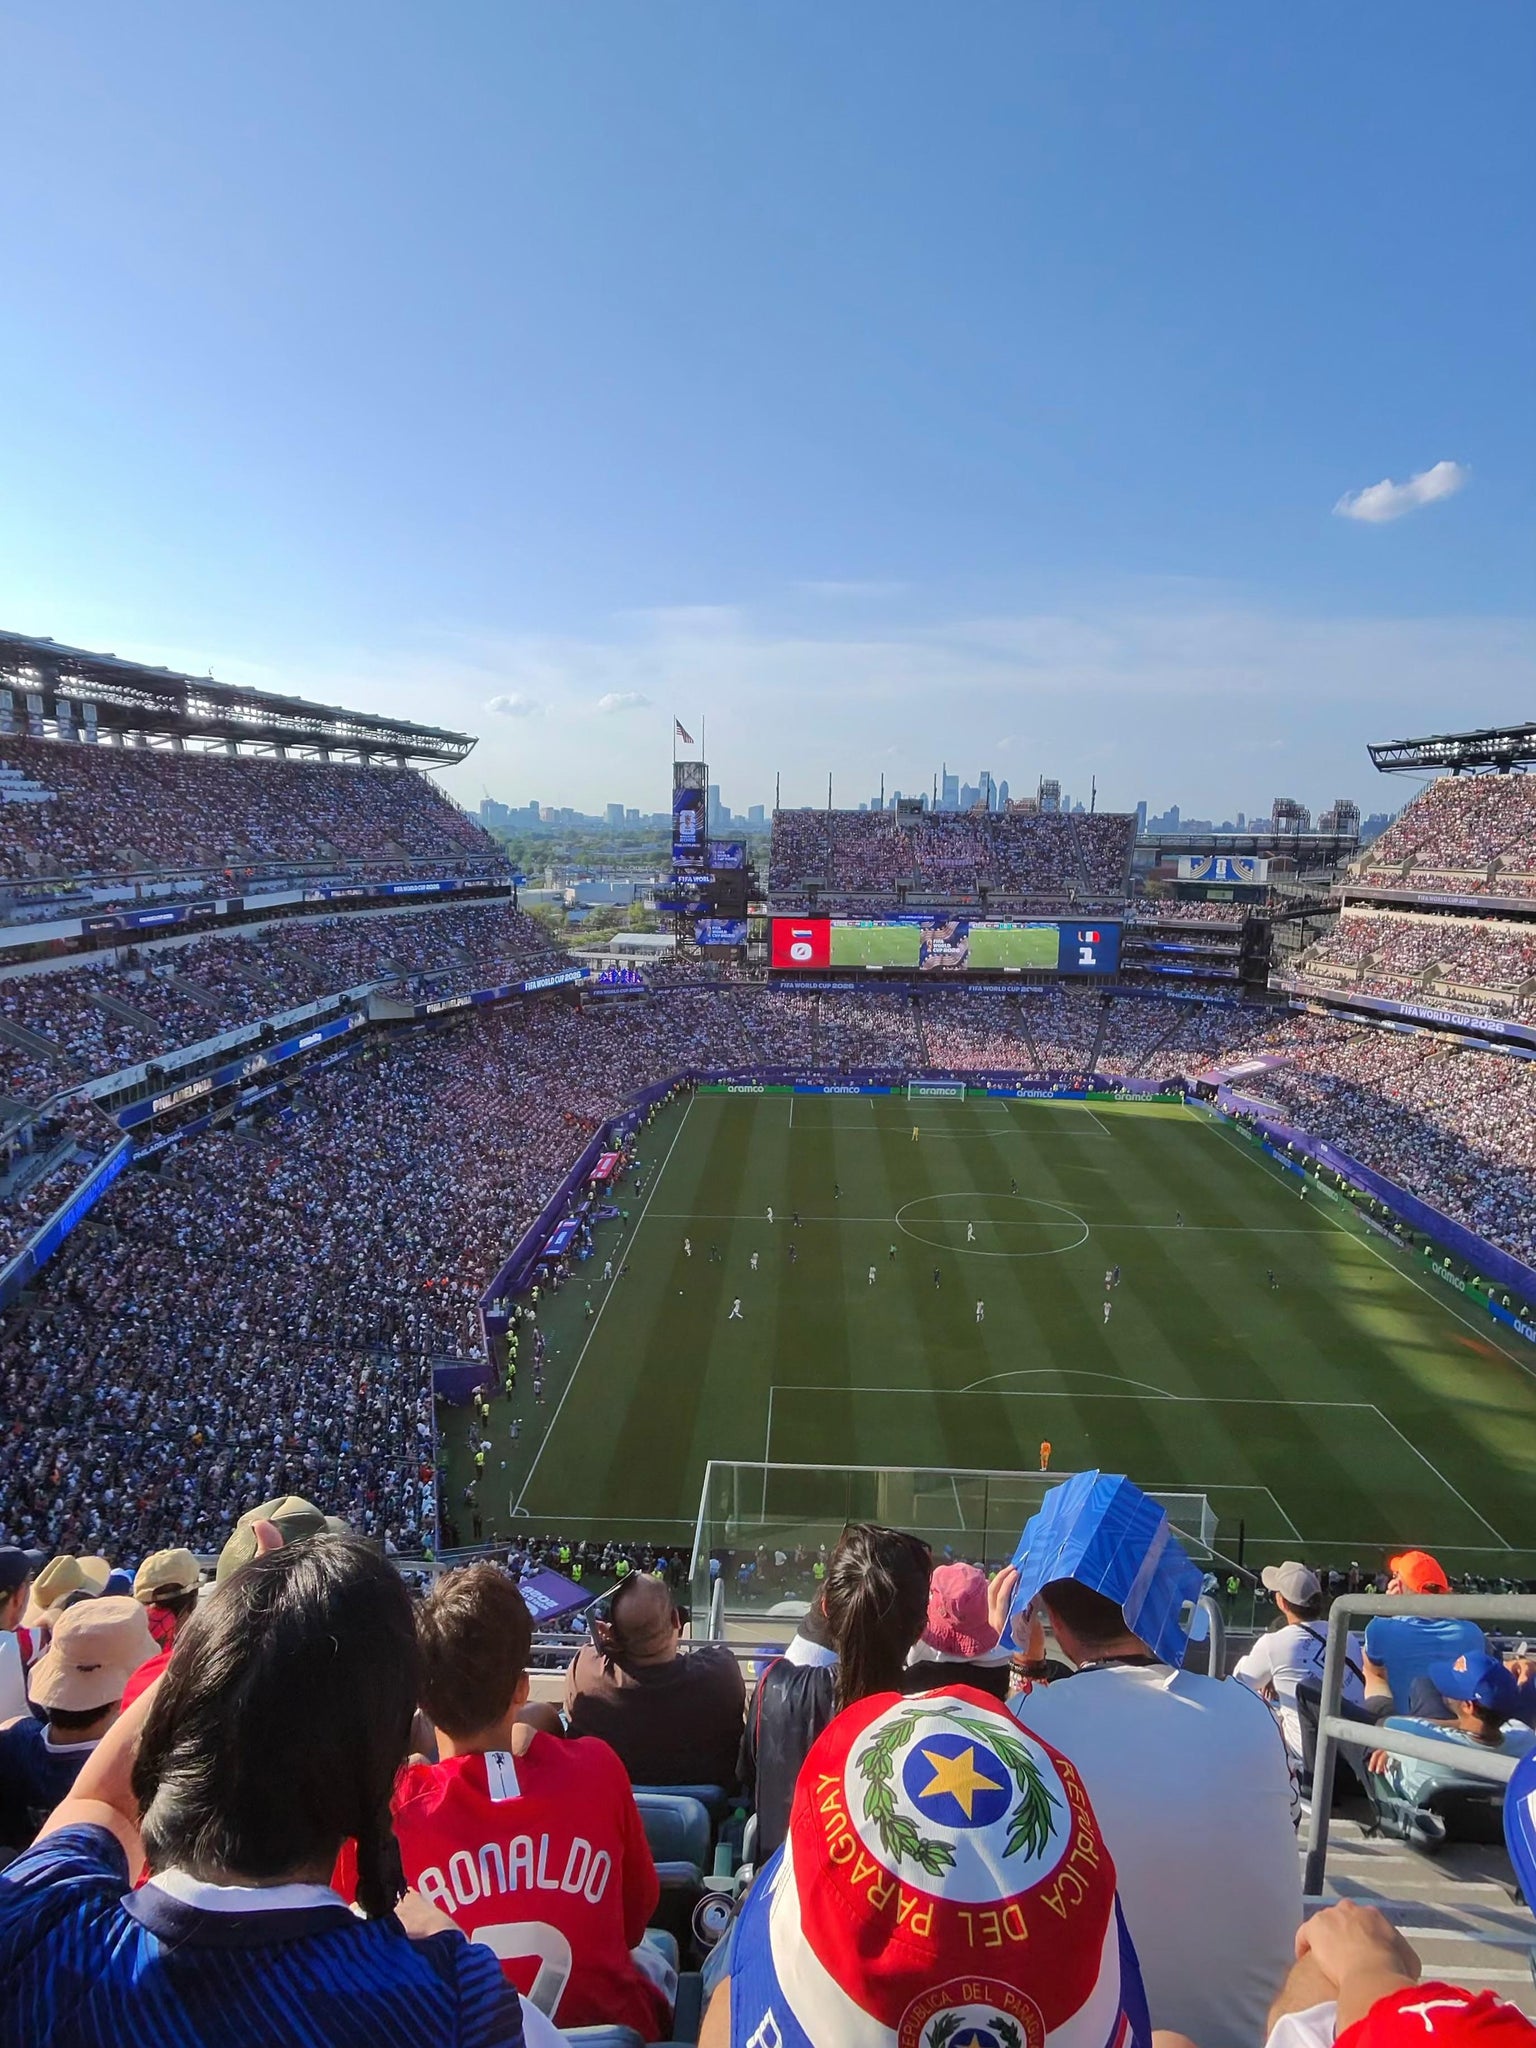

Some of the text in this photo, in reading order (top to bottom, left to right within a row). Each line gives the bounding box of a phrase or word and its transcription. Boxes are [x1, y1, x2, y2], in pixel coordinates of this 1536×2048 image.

[1078, 947, 1097, 965] 1
[525, 970, 582, 991] FIFA WORLD CUP 2026
[426, 996, 472, 1014] PHILADELPHIA
[1166, 992, 1226, 1002] PHILADELPHIA
[1400, 1005, 1505, 1033] FIFA WORLD CUP 2026
[152, 1078, 213, 1113] PHILADELPHIA
[727, 1085, 765, 1093] aramco
[823, 1086, 860, 1094] aramco
[919, 1087, 956, 1096] aramco
[1016, 1088, 1054, 1099] aramco
[1114, 1091, 1153, 1101] aramco
[132, 1131, 184, 1161] PHILADELPHIA
[1432, 1261, 1466, 1292] aramco
[816, 1773, 935, 1938] PARAGUAY
[416, 1833, 612, 1914] RONALDO
[958, 1904, 1028, 1948] DEL
[470, 1921, 573, 2021] 7
[901, 1990, 953, 2048] EPUBLICA
[962, 1982, 993, 2002] DEL
